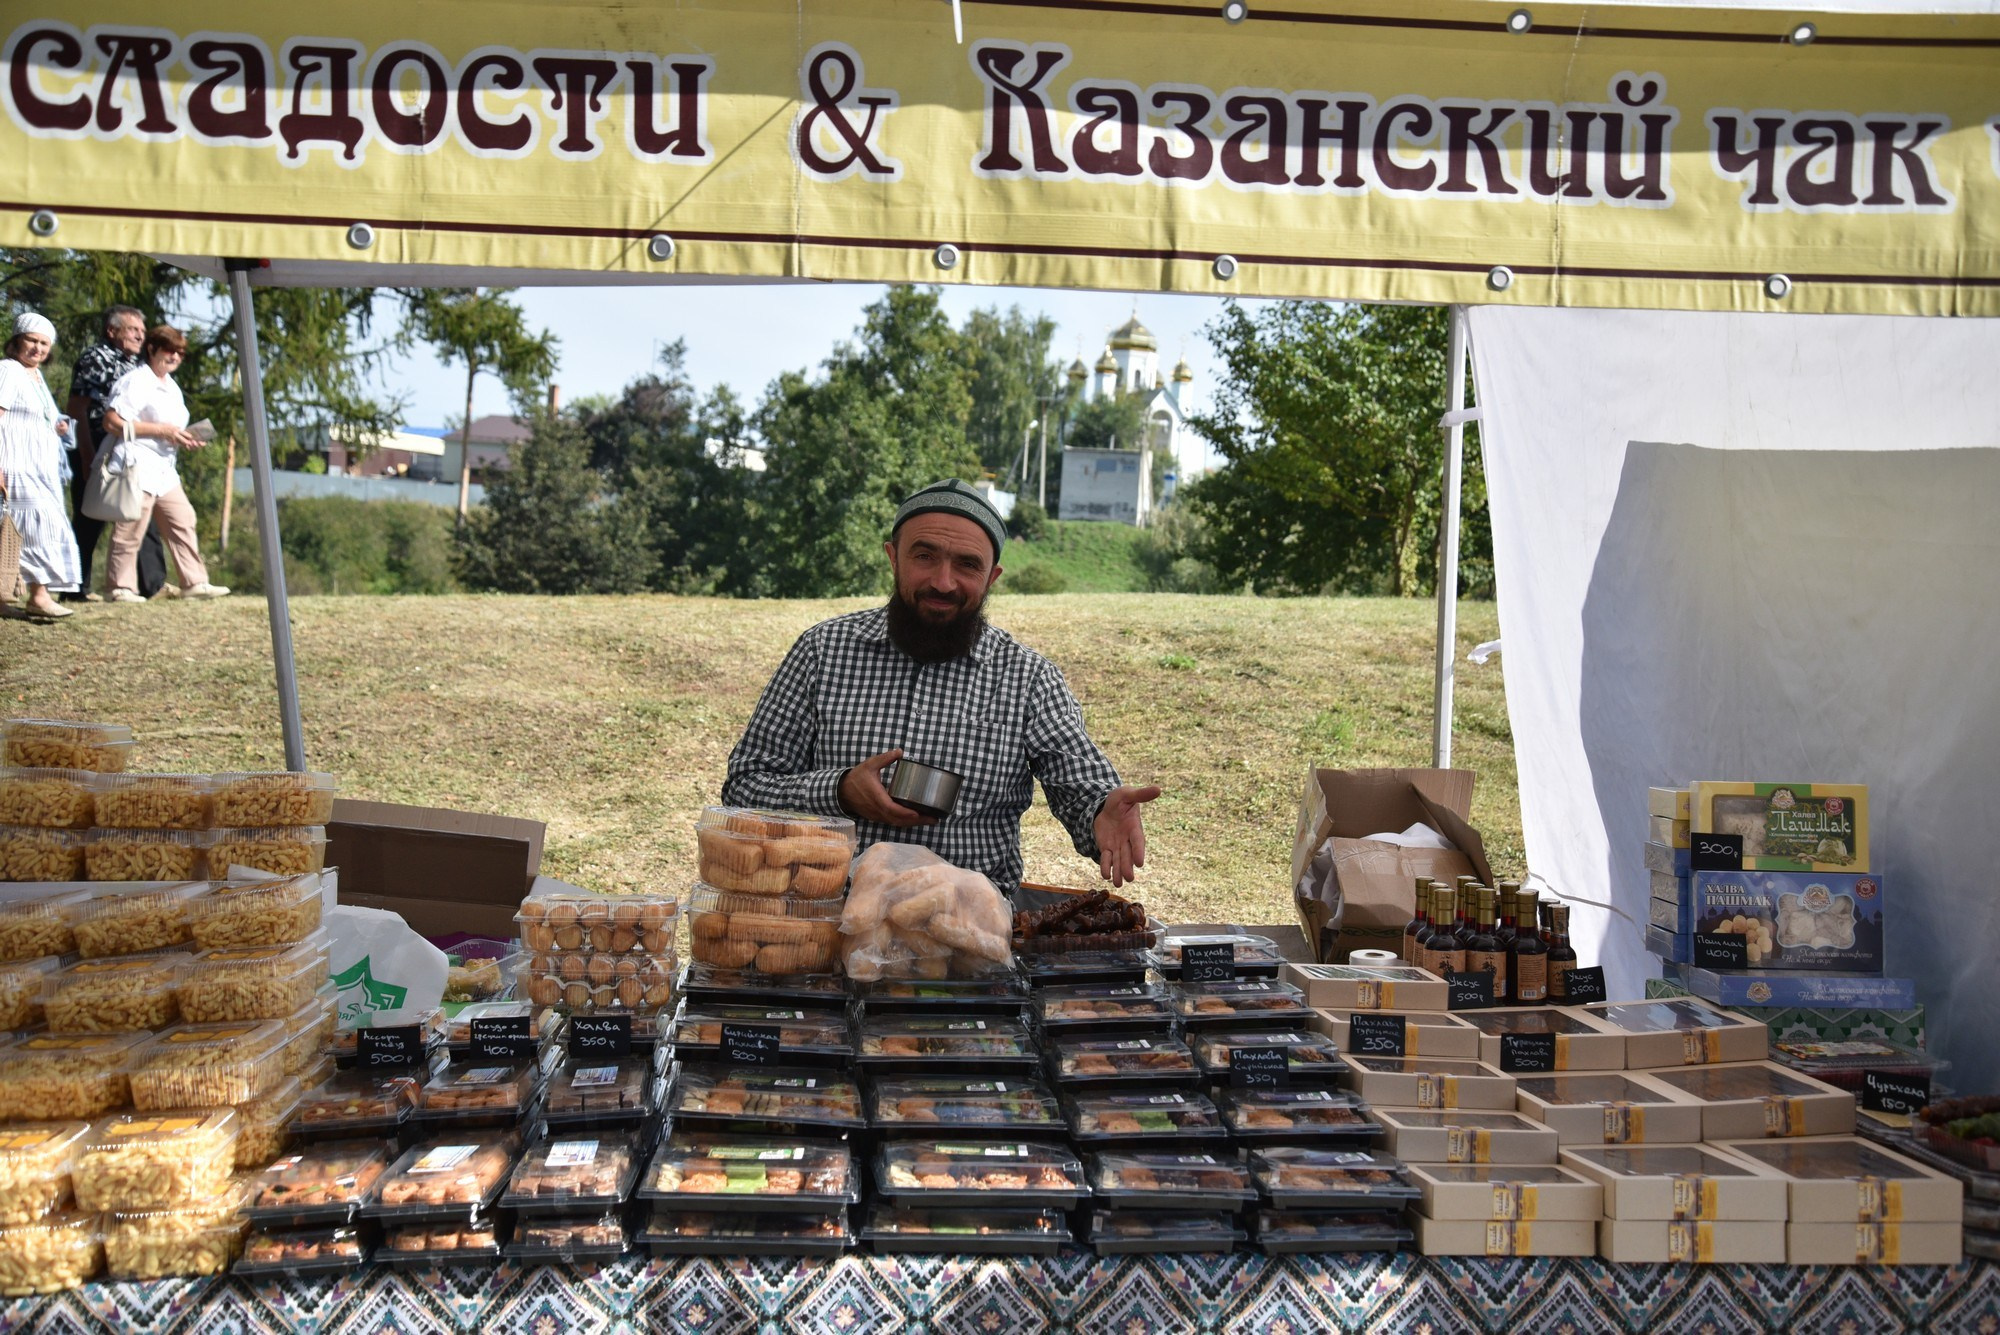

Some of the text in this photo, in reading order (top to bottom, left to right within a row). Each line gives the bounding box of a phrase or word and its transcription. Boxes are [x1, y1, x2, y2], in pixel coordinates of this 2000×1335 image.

[800, 50, 894, 174] &
[977, 47, 1672, 201] Казанский
[1712, 116, 1947, 206] чак
[1792, 811, 1816, 819] Халва
[1705, 883, 1745, 894] ХАЛВА
[1706, 894, 1773, 907] ПАШМАК
[1449, 976, 1480, 987] Уксус
[1568, 972, 1594, 982] Уксус
[1233, 1049, 1282, 1060] Пахлава
